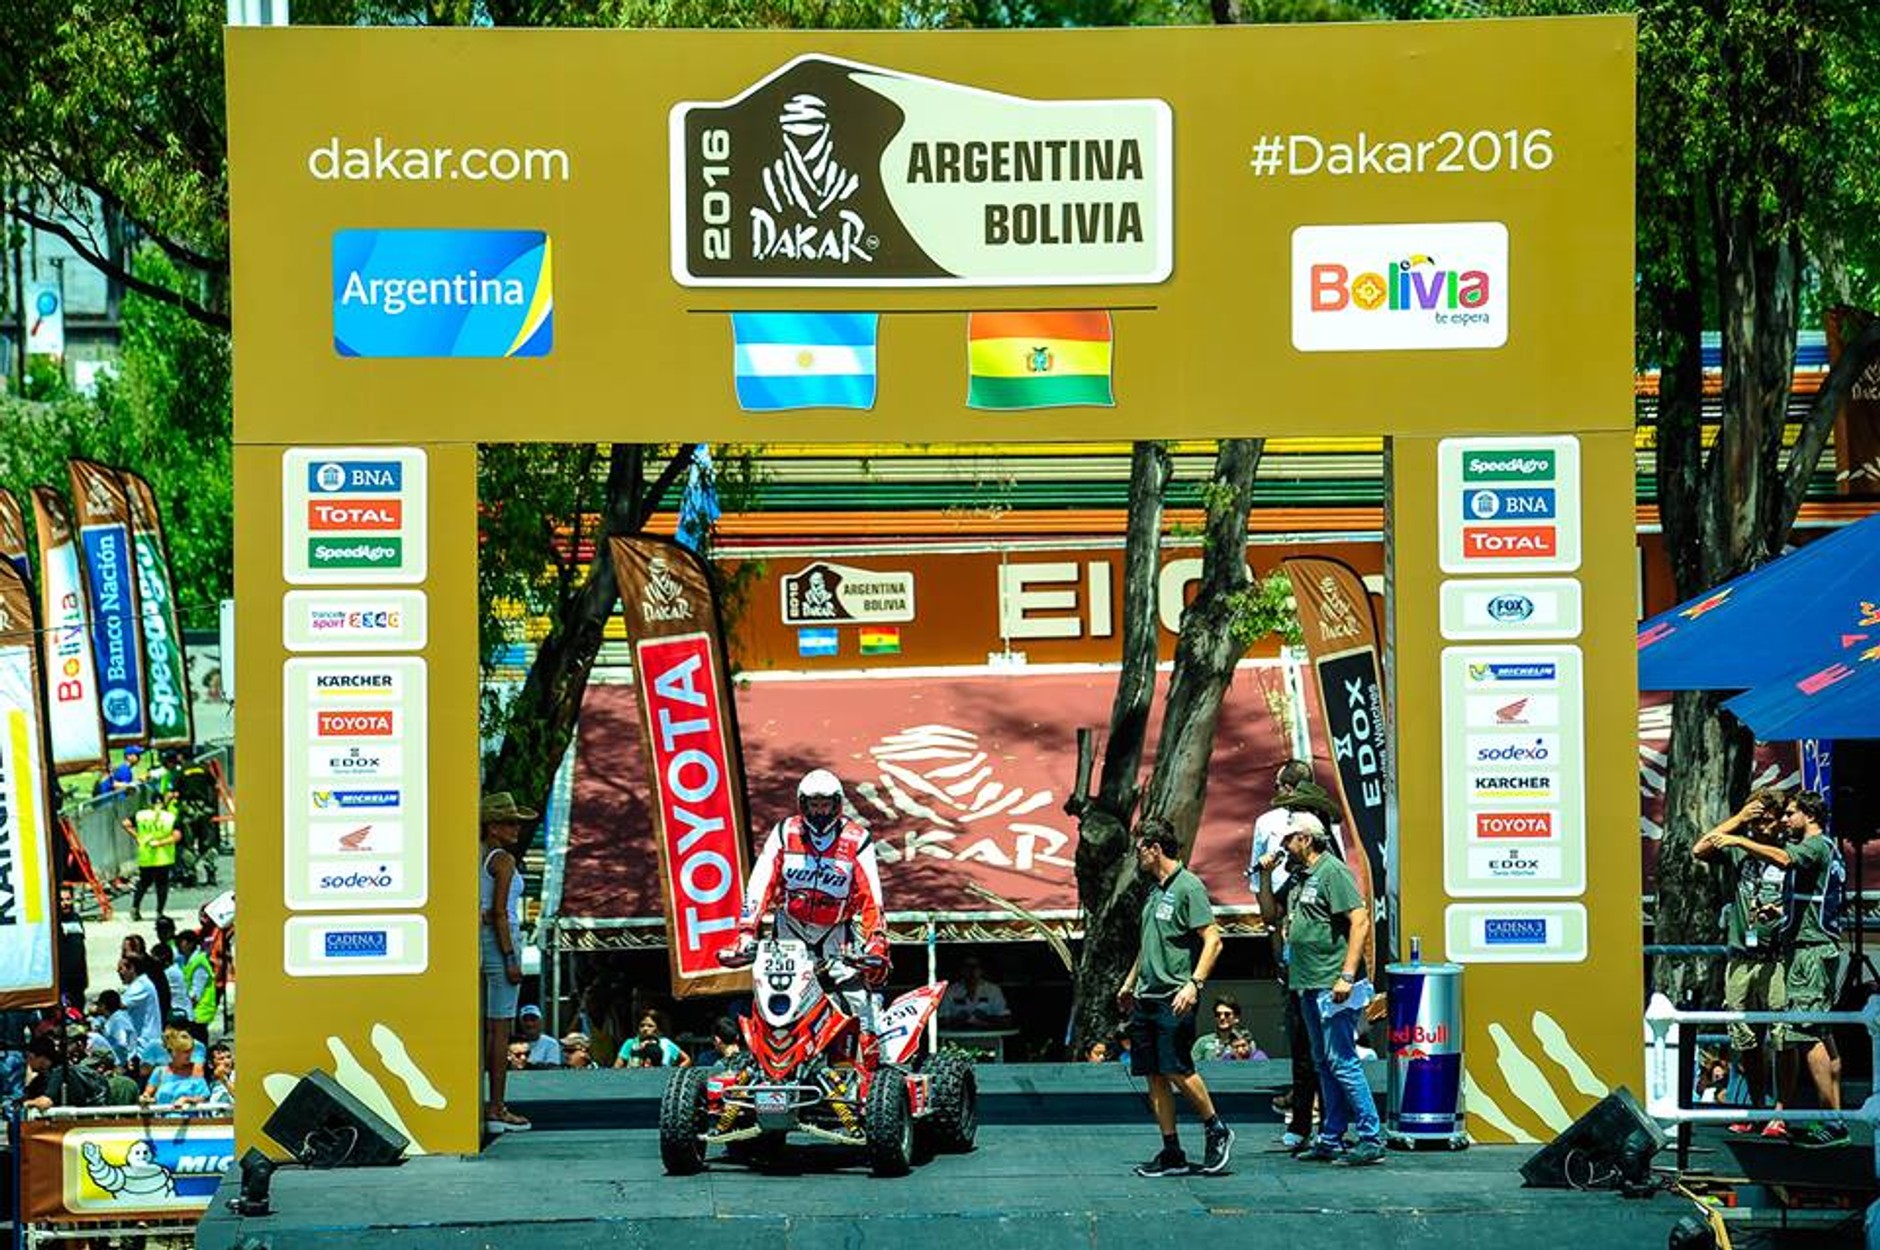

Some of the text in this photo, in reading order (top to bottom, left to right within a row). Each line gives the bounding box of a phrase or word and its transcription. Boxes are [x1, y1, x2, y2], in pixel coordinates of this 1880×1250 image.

[308, 136, 570, 181] dakar.com
[906, 137, 1144, 184] ARGENTINA
[1250, 128, 1554, 176] #Dakar2016
[702, 127, 731, 260] 2016
[984, 201, 1144, 246] BOLIVIA
[750, 206, 873, 264] DAKAR
[341, 270, 524, 315] Argentina
[1310, 260, 1490, 312] Bolivia
[1435, 311, 1490, 326] te espera
[1469, 458, 1549, 474] SpeedAgro
[352, 470, 395, 486] BNA
[1505, 496, 1549, 513] BNA
[315, 505, 395, 523] TOTAL
[1471, 533, 1549, 550] TOTAL
[315, 545, 396, 561] SpeedAgro
[843, 582, 907, 596] ARGENTINA
[863, 599, 907, 612] BOLIVIA
[1496, 599, 1523, 611] FOX
[312, 618, 346, 630] sport
[58, 593, 83, 703] Bolivia
[105, 617, 126, 682] Banco
[1498, 667, 1553, 678] MICHELIN
[321, 715, 390, 731] TOYOTA
[1344, 676, 1382, 808] EDOX
[1477, 743, 1549, 762] sodexo
[329, 758, 380, 768] EDOX
[654, 652, 737, 952] TOYOTA
[1480, 817, 1548, 833] TOYOTA
[875, 822, 1076, 871] AKAR
[1488, 859, 1540, 870] EDOX
[320, 870, 393, 889] sodexo
[764, 958, 796, 972] 250
[882, 1003, 919, 1027] 250
[1413, 1024, 1448, 1044] Bull
